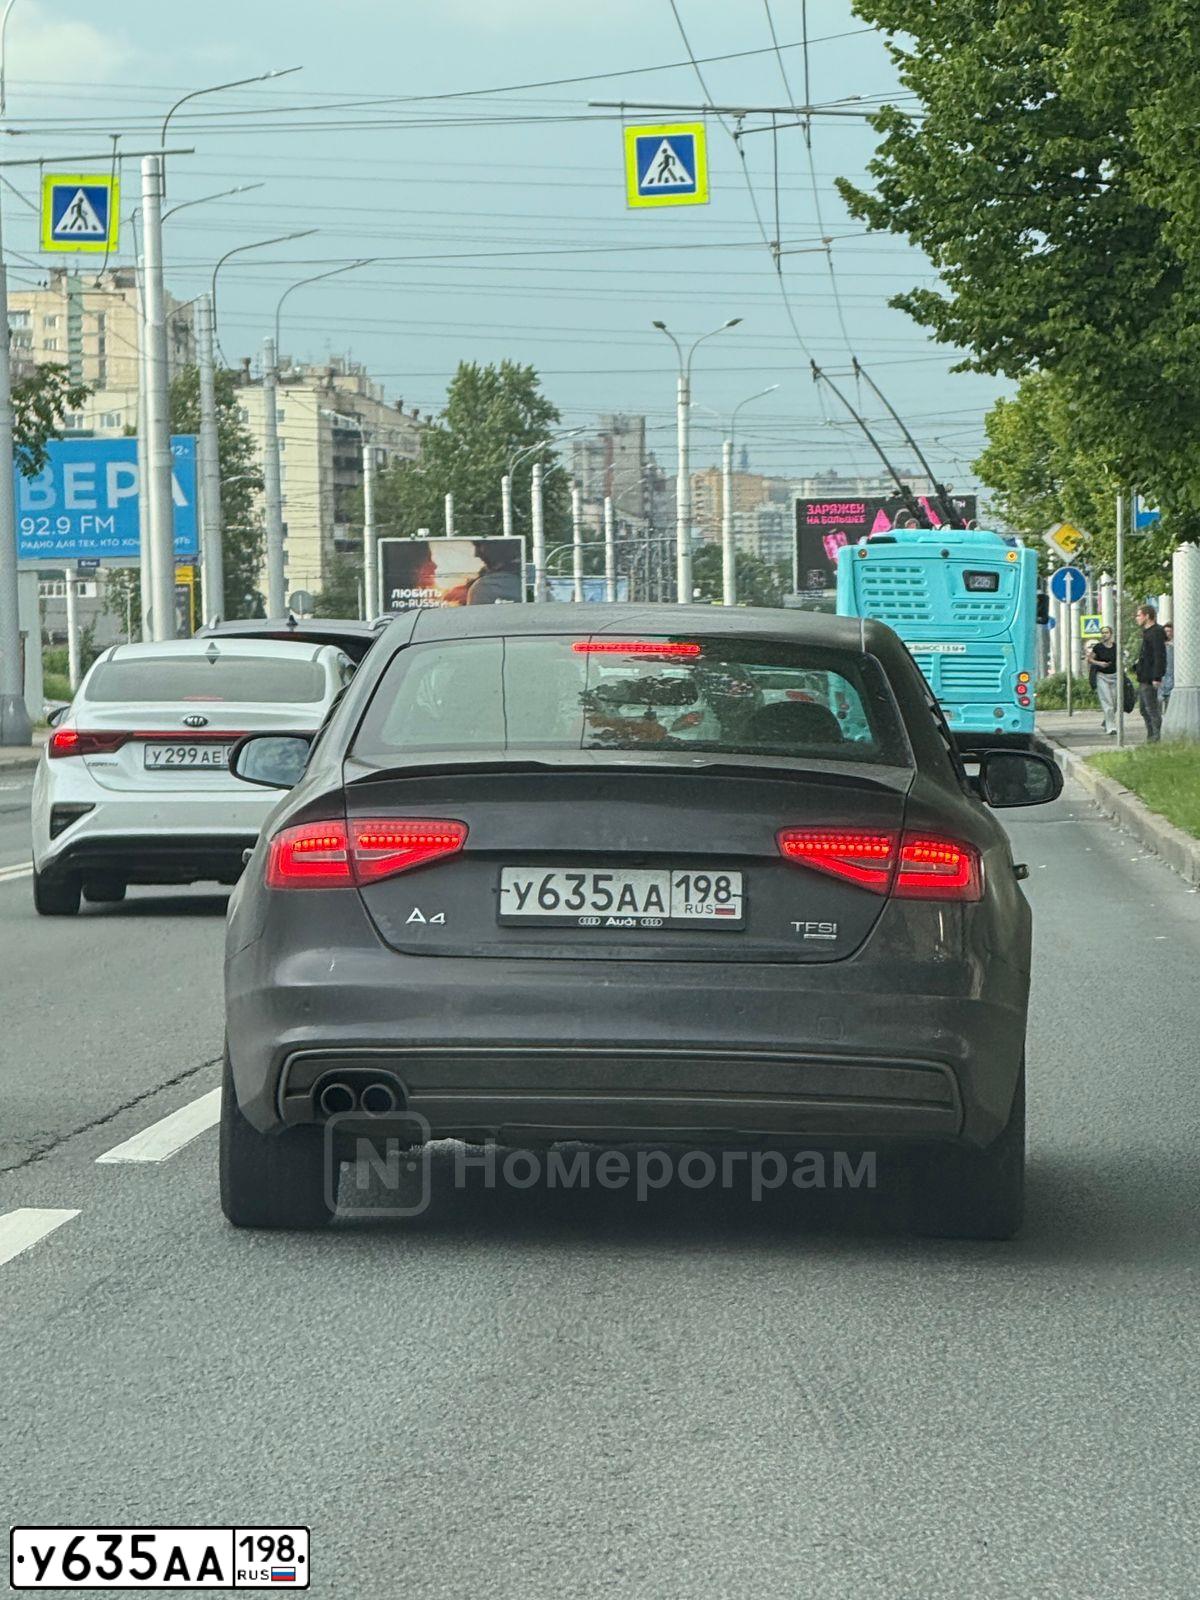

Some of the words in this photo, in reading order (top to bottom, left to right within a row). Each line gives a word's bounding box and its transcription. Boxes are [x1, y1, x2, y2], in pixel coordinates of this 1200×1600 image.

[807, 503, 865, 515] ЗАРЯЖЕН
[20, 516, 71, 536] 92.9
[80, 515, 115, 534] FM
[807, 516, 819, 524] НА
[20, 540, 54, 550] РАДИО
[56, 540, 76, 549] ДЛЯ
[187, 717, 207, 726] KIA
[513, 873, 665, 913] У635АА
[674, 874, 732, 904] 198
[684, 904, 714, 915] RUS
[606, 916, 637, 926] Audi
[790, 921, 837, 933] TFSI
